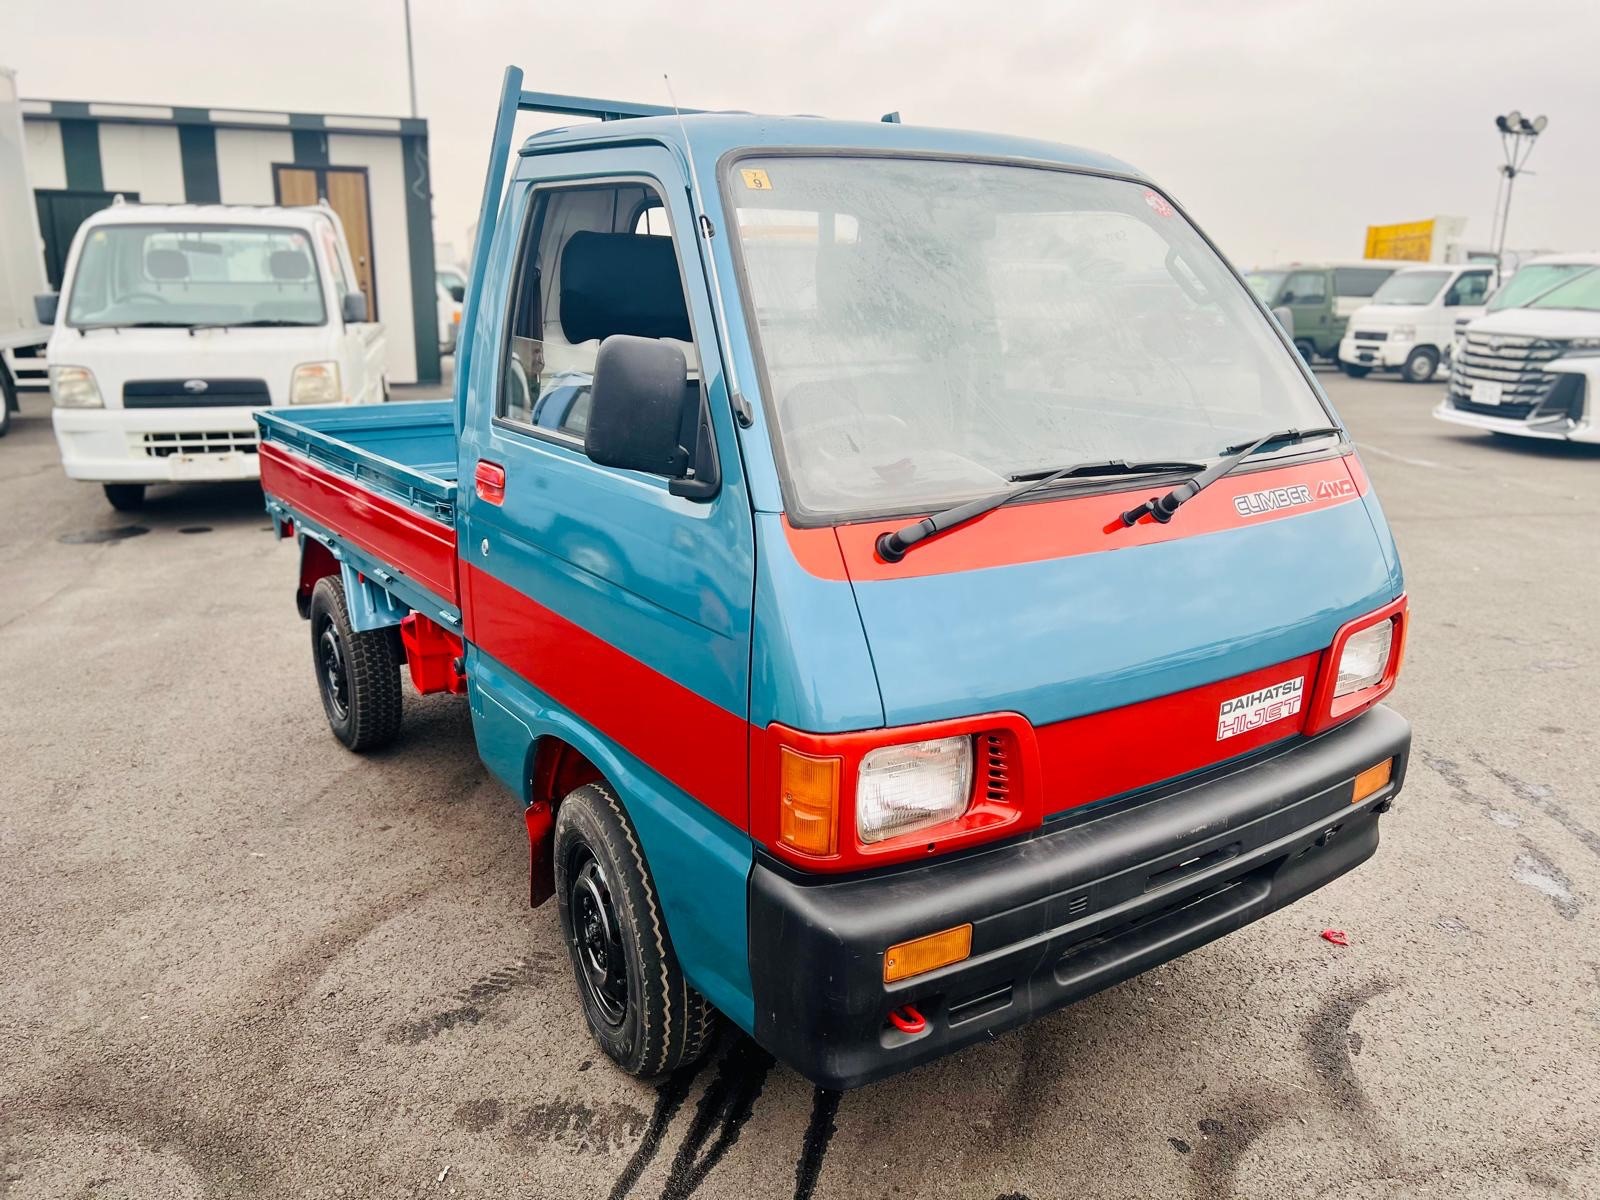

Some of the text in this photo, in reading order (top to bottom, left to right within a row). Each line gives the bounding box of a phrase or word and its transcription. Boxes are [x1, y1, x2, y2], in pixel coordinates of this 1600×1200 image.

[753, 178, 763, 188] 9
[1233, 480, 1355, 516] CLIMBER 4WD
[1220, 678, 1303, 716] DAIHATSU
[1218, 695, 1301, 739] HIJET
